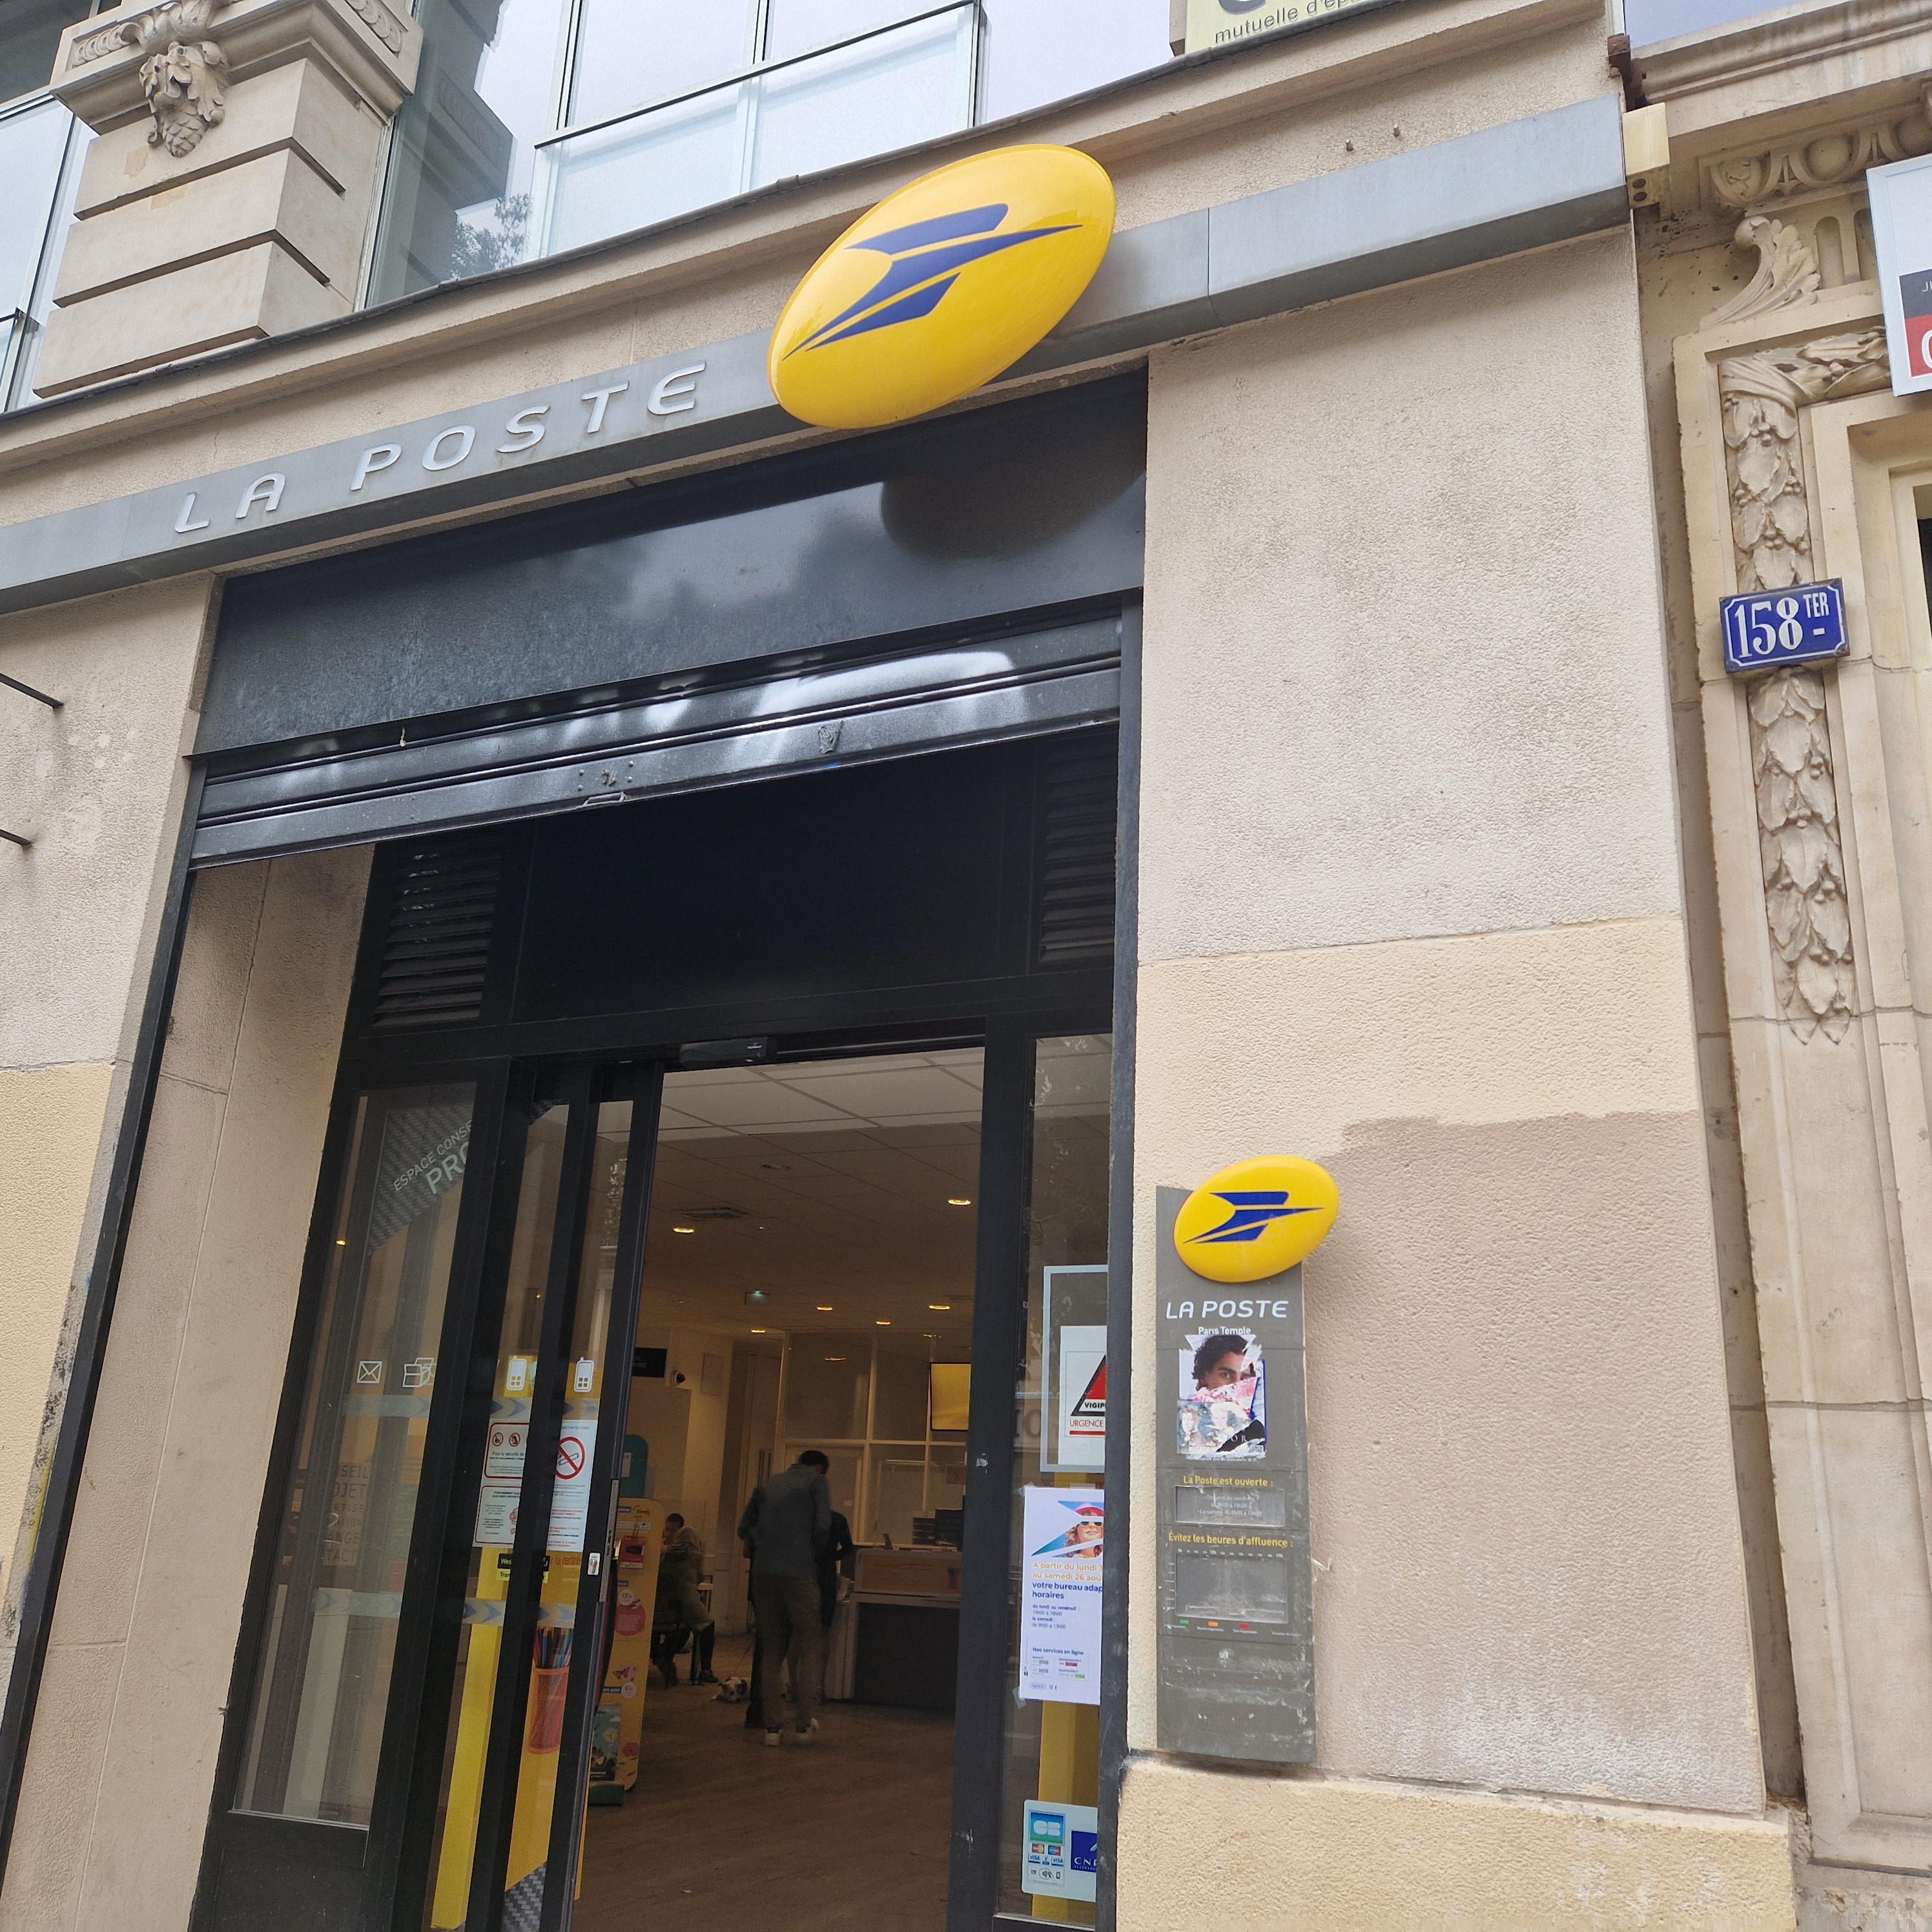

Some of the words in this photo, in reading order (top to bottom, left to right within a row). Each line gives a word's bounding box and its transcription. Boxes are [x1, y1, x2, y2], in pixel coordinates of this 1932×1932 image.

[1215, 7, 1298, 43] mutuelle
[174, 472, 286, 534] LA
[351, 361, 708, 491] POSTE
[1734, 597, 1804, 658] 158
[1803, 591, 1829, 619] TER
[393, 1151, 436, 1191] ESPACE
[1166, 1300, 1194, 1319] LA
[1202, 1300, 1289, 1319] POSTE
[1198, 1326, 1219, 1335] Paris
[1220, 1326, 1251, 1335] Temple
[1069, 1419, 1104, 1428] URGENCE
[1183, 1475, 1193, 1484] La
[1195, 1476, 1218, 1485] Poste
[1235, 1477, 1268, 1486] ouverte
[1169, 1530, 1191, 1542] Évitez
[1193, 1534, 1206, 1543] les
[1207, 1534, 1236, 1545] heures
[1238, 1536, 1288, 1548] d'affluence
[1041, 1563, 1062, 1571] partir
[1033, 1590, 1064, 1599] horaires
[1054, 1582, 1082, 1591] bureau
[1084, 1584, 1103, 1594] adap
